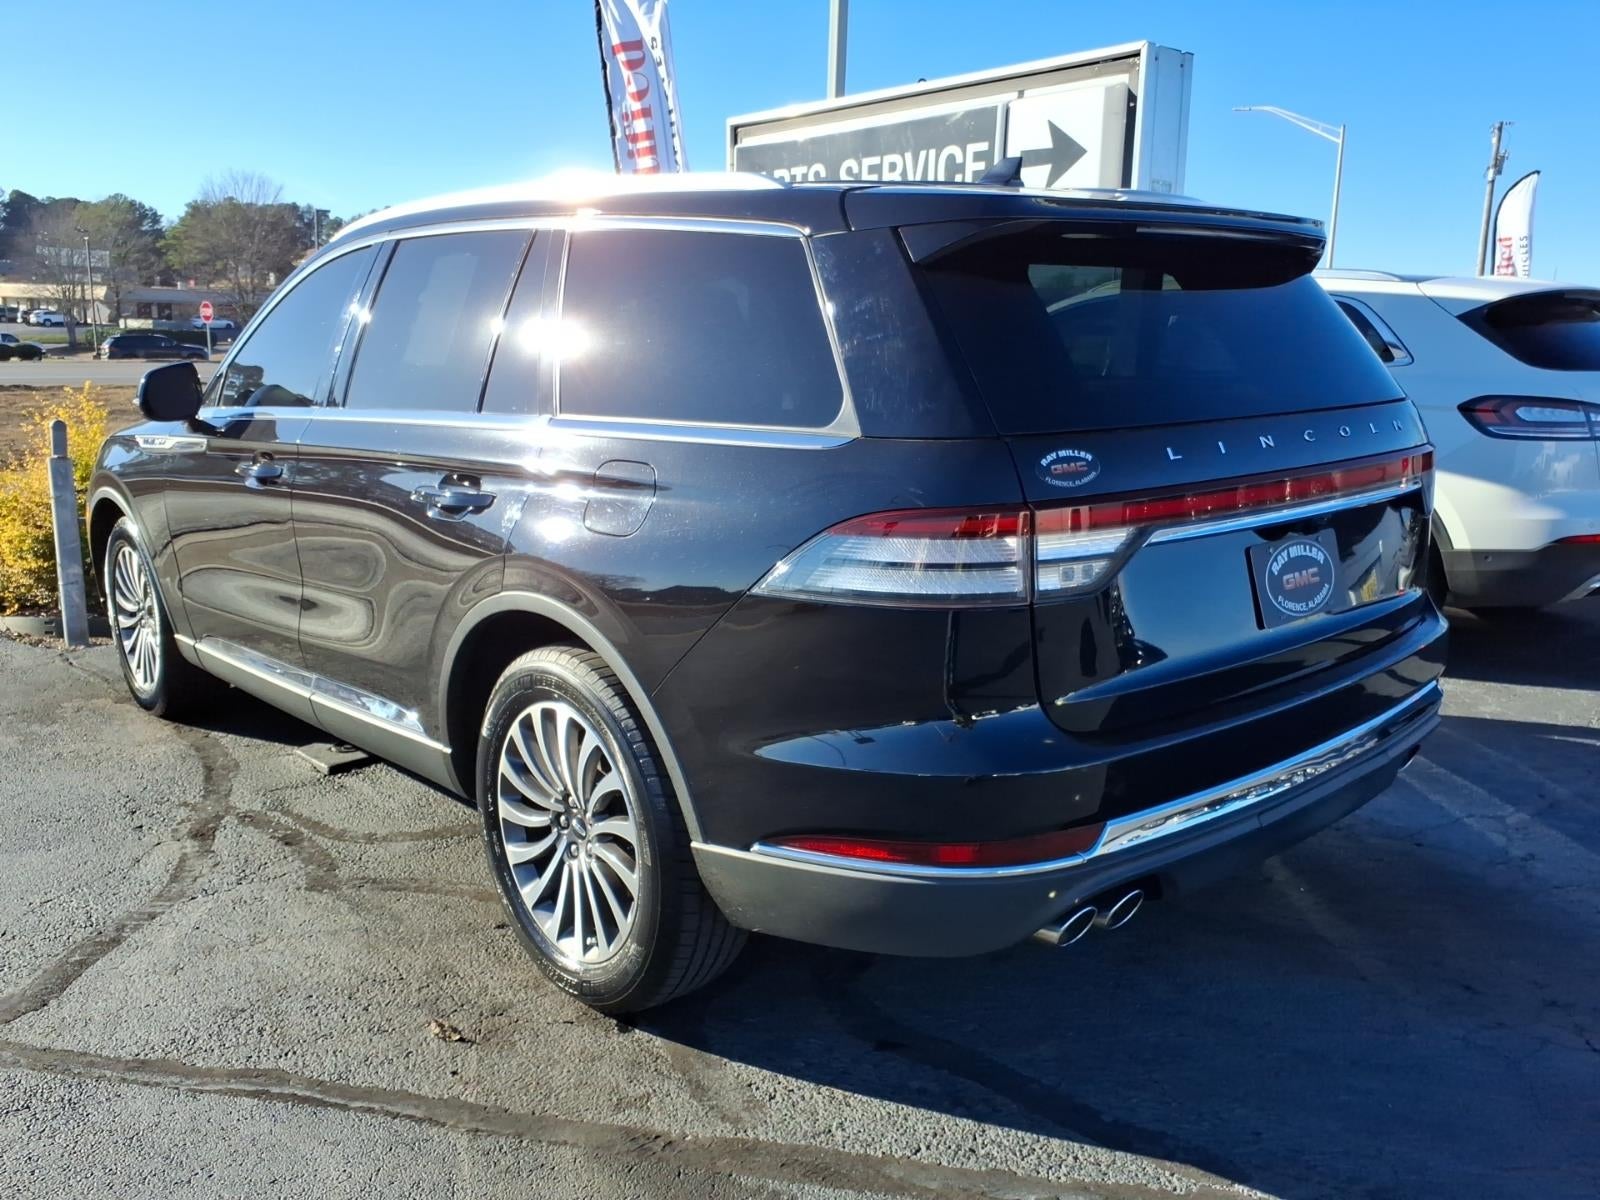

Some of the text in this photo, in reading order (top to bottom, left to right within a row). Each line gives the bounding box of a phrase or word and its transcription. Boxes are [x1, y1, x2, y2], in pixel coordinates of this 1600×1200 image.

[839, 141, 990, 183] SERVICE
[1166, 419, 1402, 460] LINCOLN
[1041, 450, 1092, 466] RAY MILLER
[1051, 462, 1088, 473] GMC
[1272, 545, 1325, 575] RAY MILLER
[1282, 568, 1320, 590] GMC
[1308, 583, 1330, 608] ALABAMA
